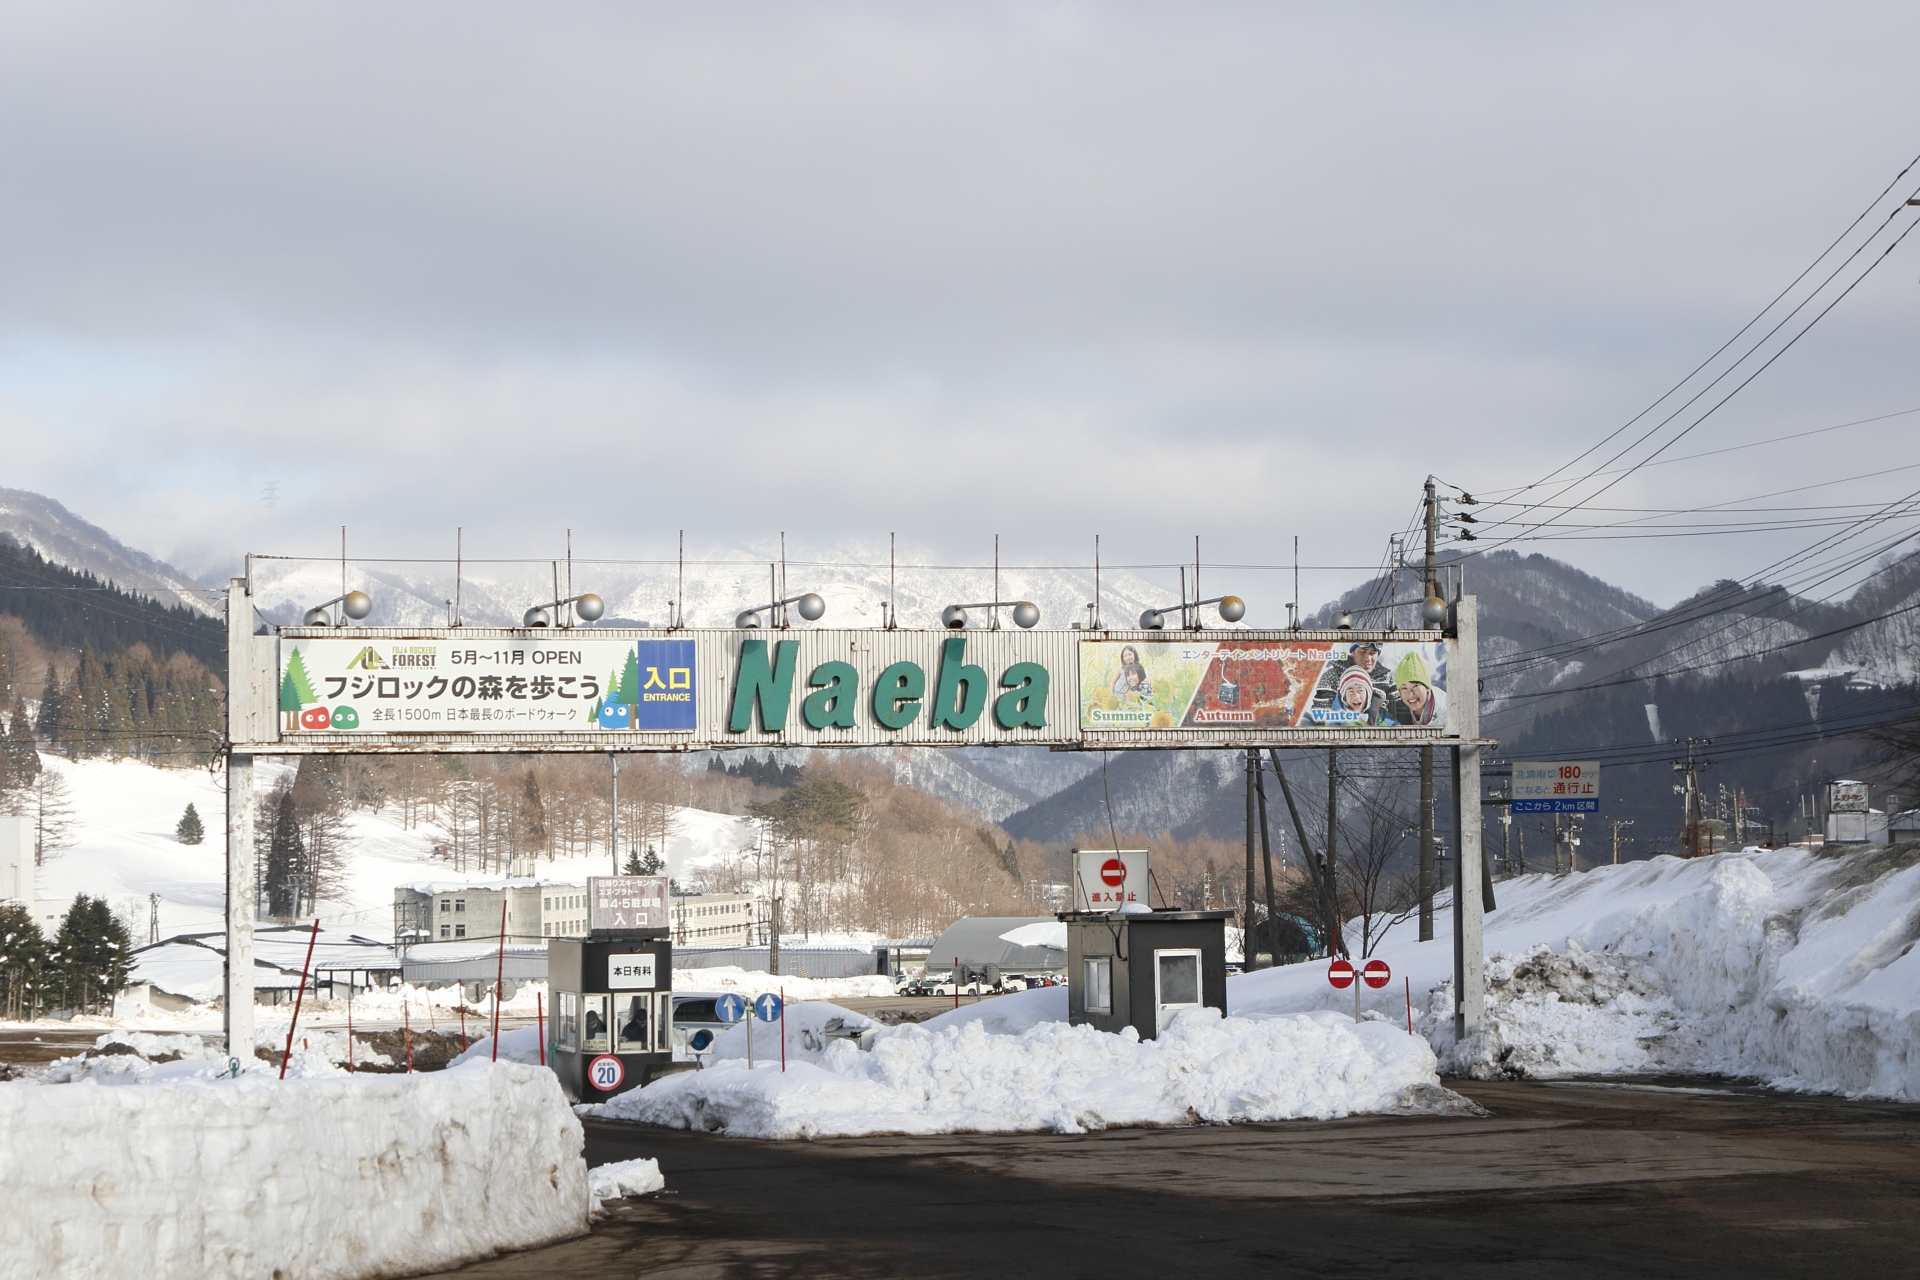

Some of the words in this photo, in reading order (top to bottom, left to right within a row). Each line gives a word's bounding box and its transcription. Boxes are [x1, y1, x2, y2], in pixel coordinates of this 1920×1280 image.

[409, 646, 437, 654] ROCKERS
[1182, 649, 1306, 661] エンターテインメントリゾート
[1308, 649, 1348, 661] Naeba
[392, 655, 437, 666] FOREST
[532, 651, 582, 665] OPEN
[643, 666, 691, 690] 入口
[325, 675, 600, 701] フジロックの森を歩こう
[730, 638, 1050, 732] Naeba
[643, 693, 691, 703] ENTRANCE
[372, 708, 442, 721] 全長1500m
[446, 708, 578, 721] 日本最長のボードウォーク
[1092, 710, 1153, 722] Summer
[1195, 710, 1254, 722] Autumn
[1311, 710, 1361, 722] Winter
[598, 879, 662, 887] 日帰りスキーセンター
[1092, 892, 1137, 902] 進入禁止
[613, 912, 648, 926] 入口
[613, 965, 652, 977] 本日有料
[597, 1067, 616, 1084] 20
